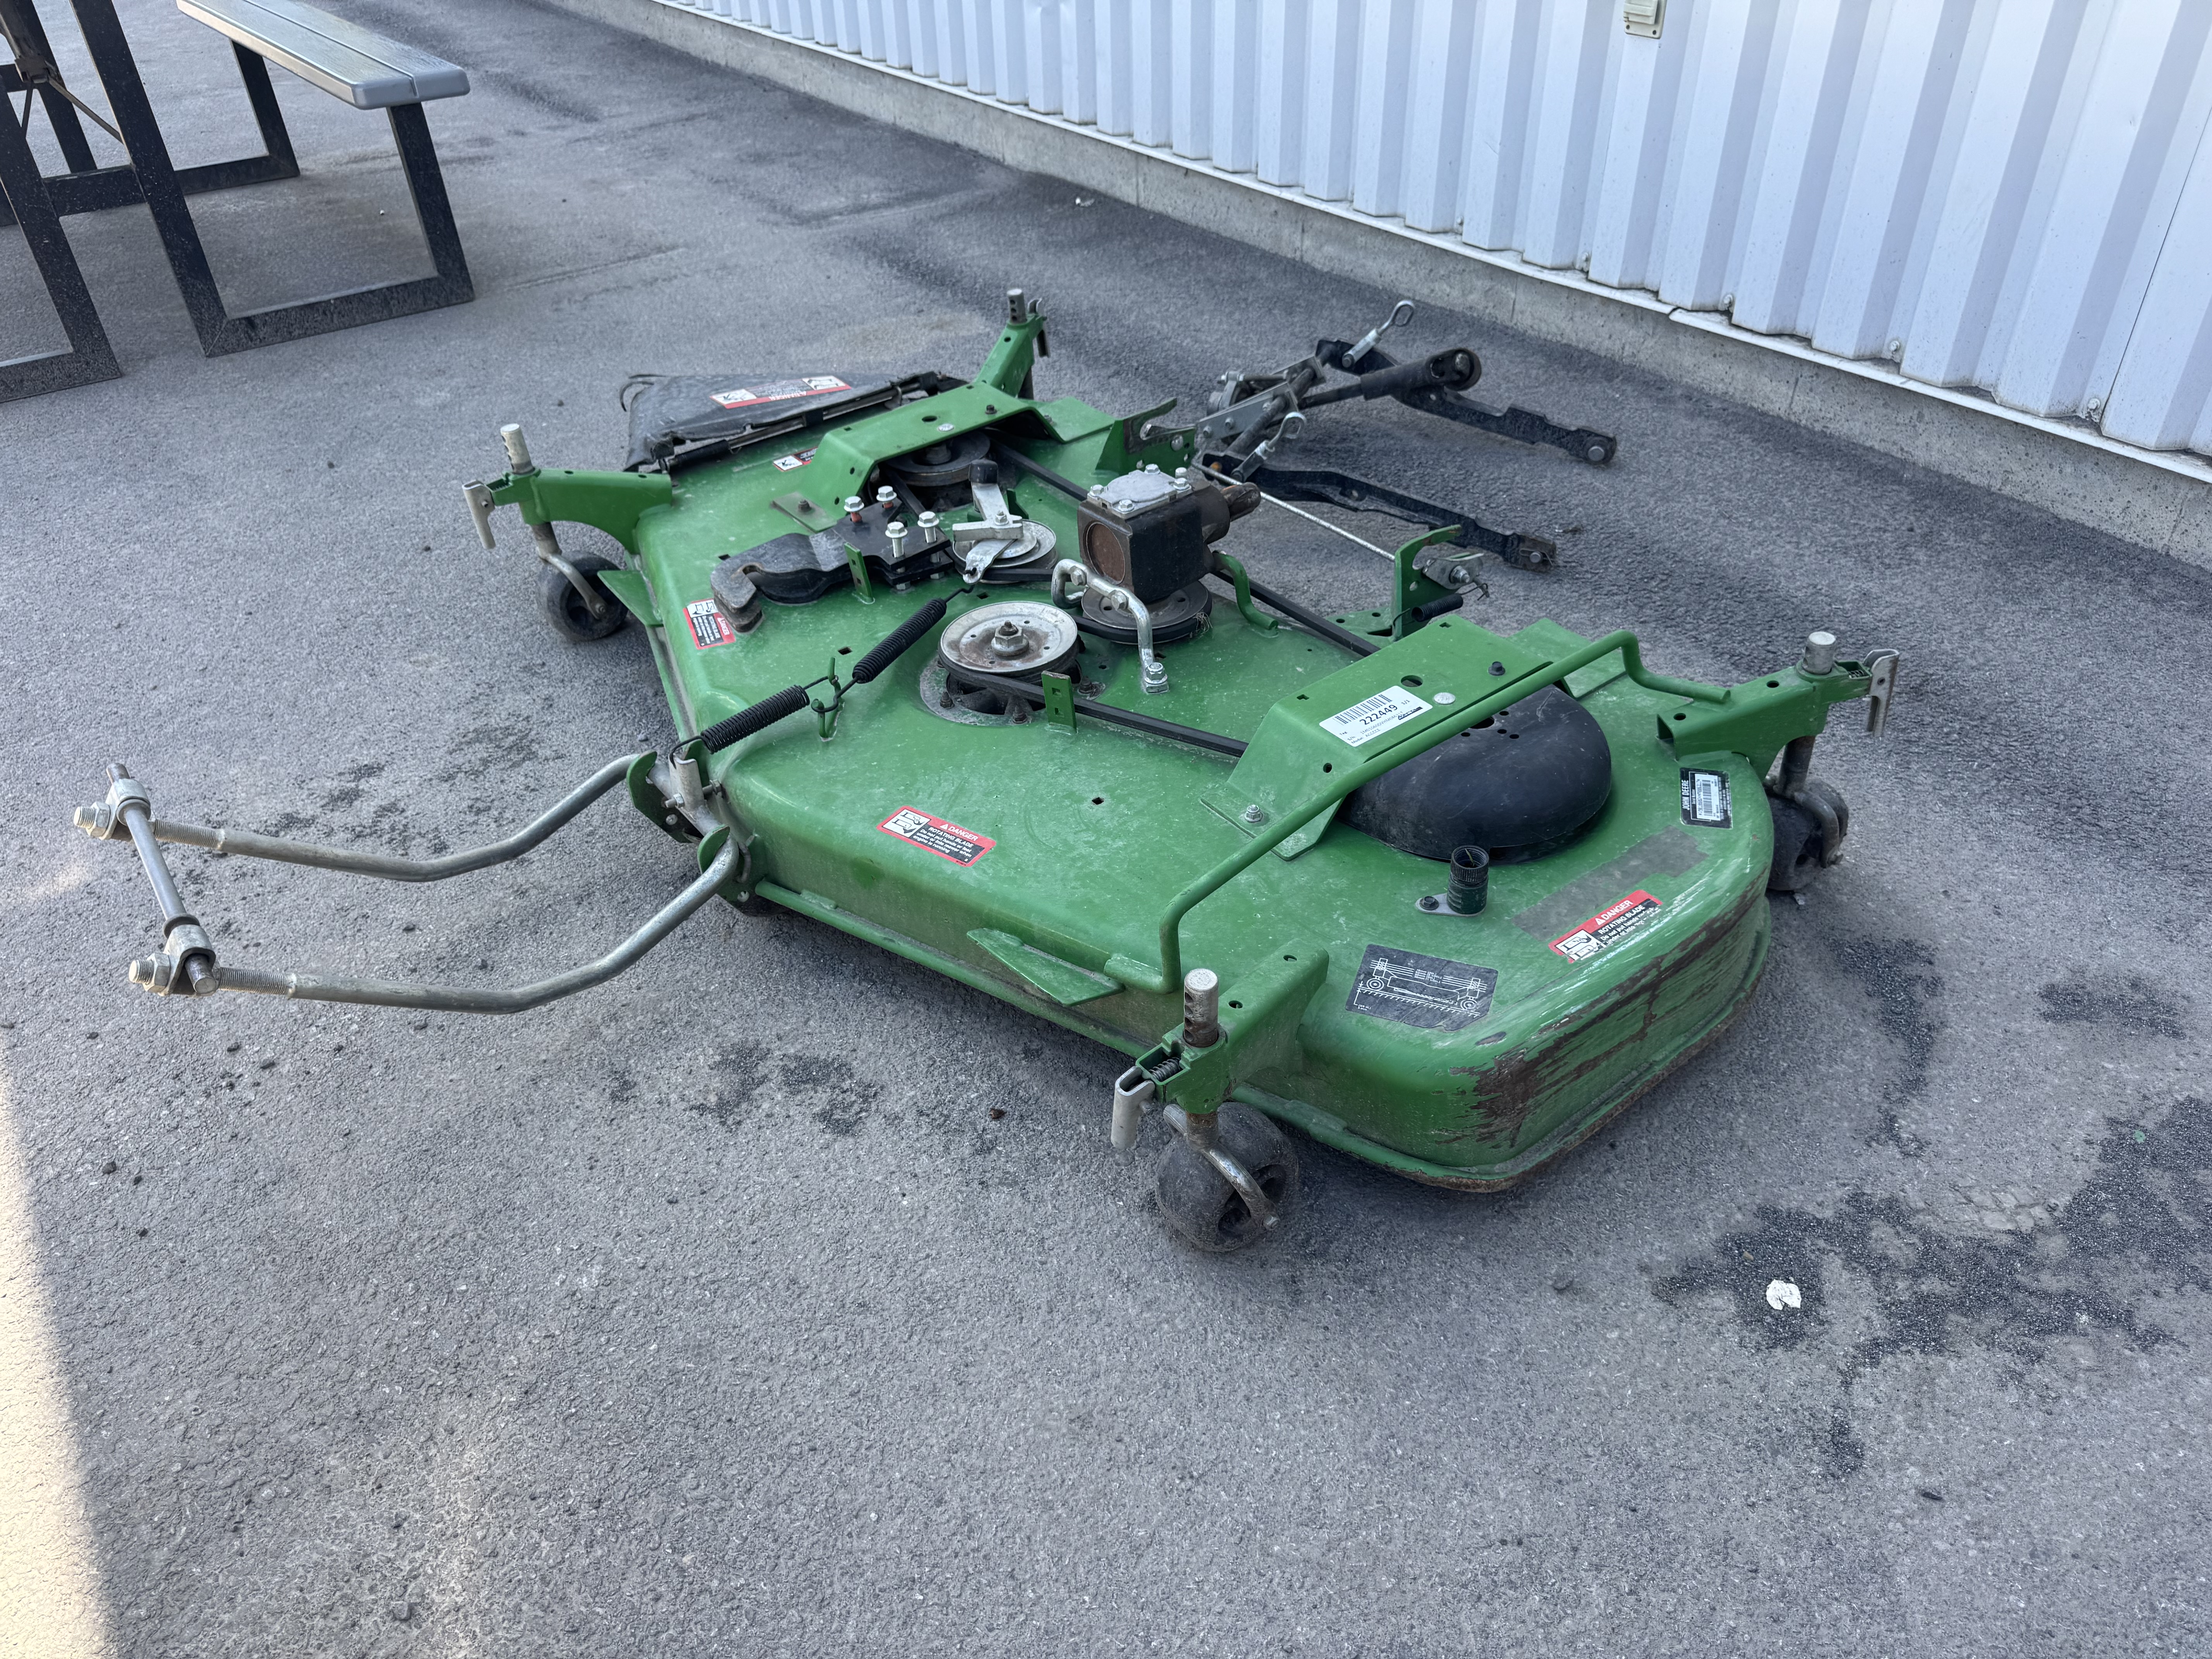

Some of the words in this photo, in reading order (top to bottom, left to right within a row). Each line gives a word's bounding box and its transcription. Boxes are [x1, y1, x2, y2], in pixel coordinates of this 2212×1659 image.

[1360, 705, 1397, 725] 222449
[928, 827, 955, 840] ROTATING
[955, 838, 974, 847] BLADE
[948, 826, 978, 841] DANGER
[933, 844, 950, 853] running
[1598, 916, 1627, 934] ROTATING
[1625, 905, 1645, 918] BLADE
[1601, 900, 1633, 920] DANGER
[1623, 917, 1639, 926] hands
